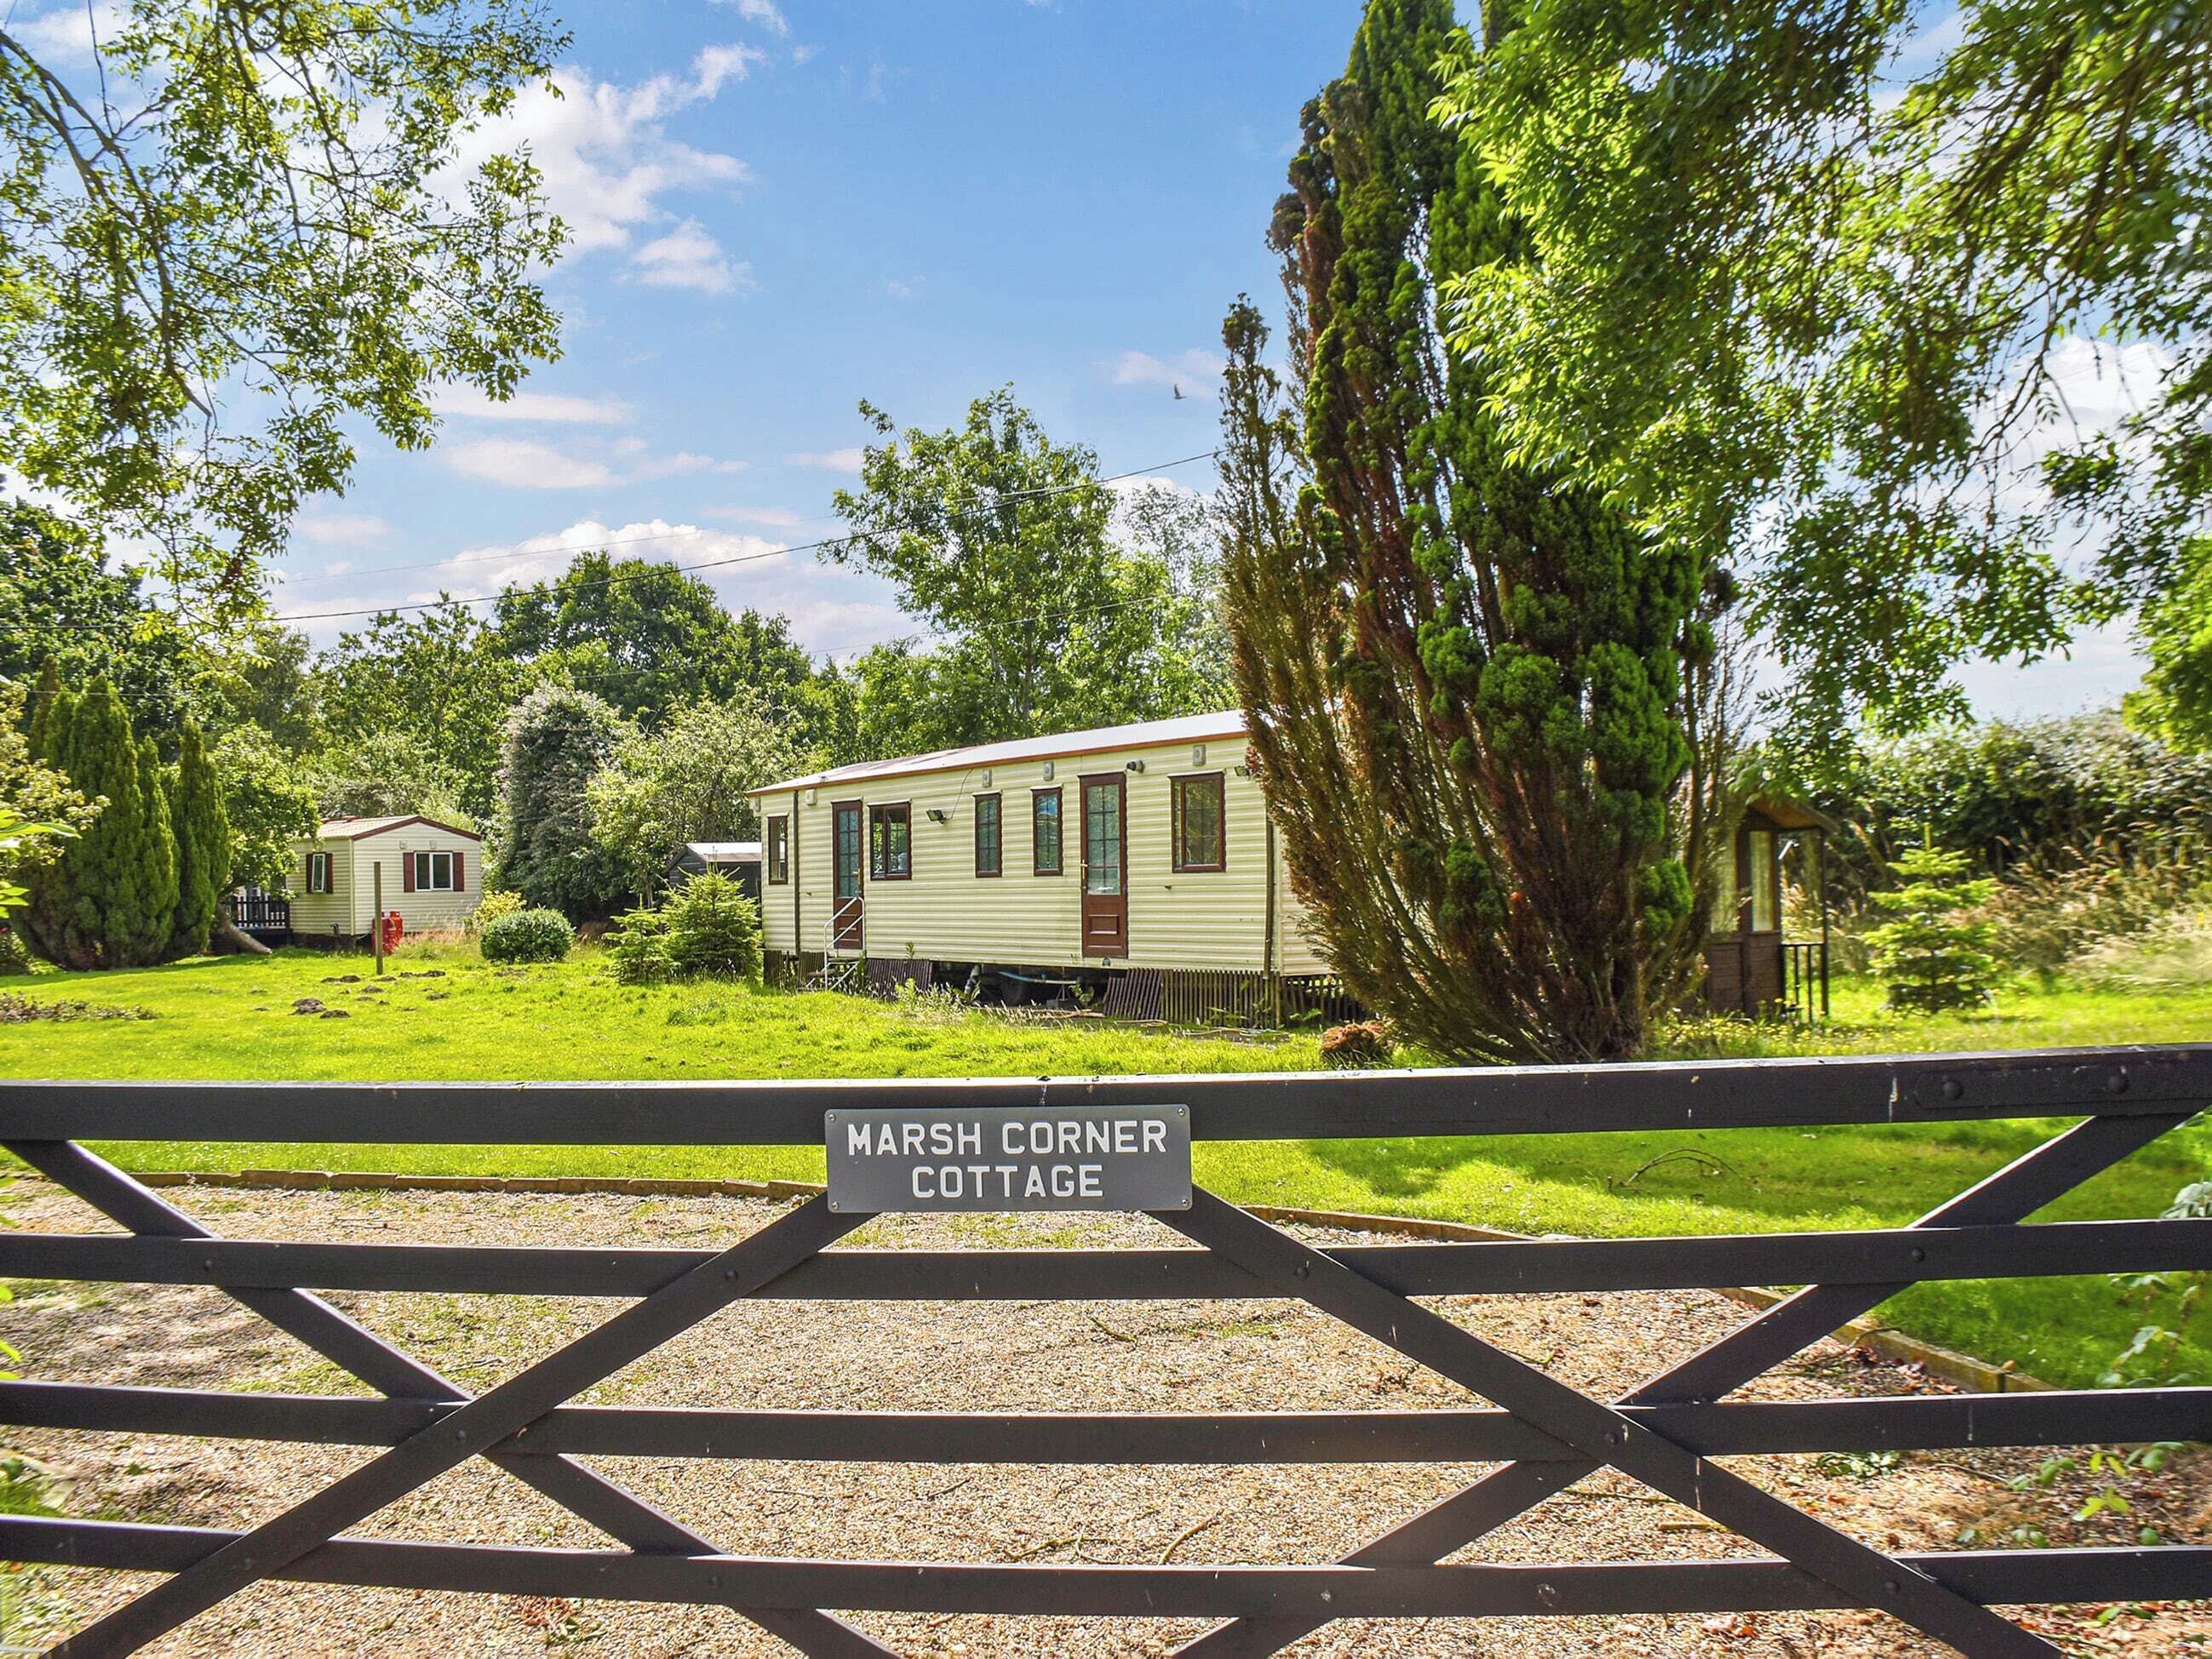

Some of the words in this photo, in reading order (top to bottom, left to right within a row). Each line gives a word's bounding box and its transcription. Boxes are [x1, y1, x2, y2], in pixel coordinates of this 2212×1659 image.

[846, 1122, 982, 1156] MARSH
[1002, 1120, 1167, 1154] CORNER
[912, 1164, 1103, 1198] COTTAGE
